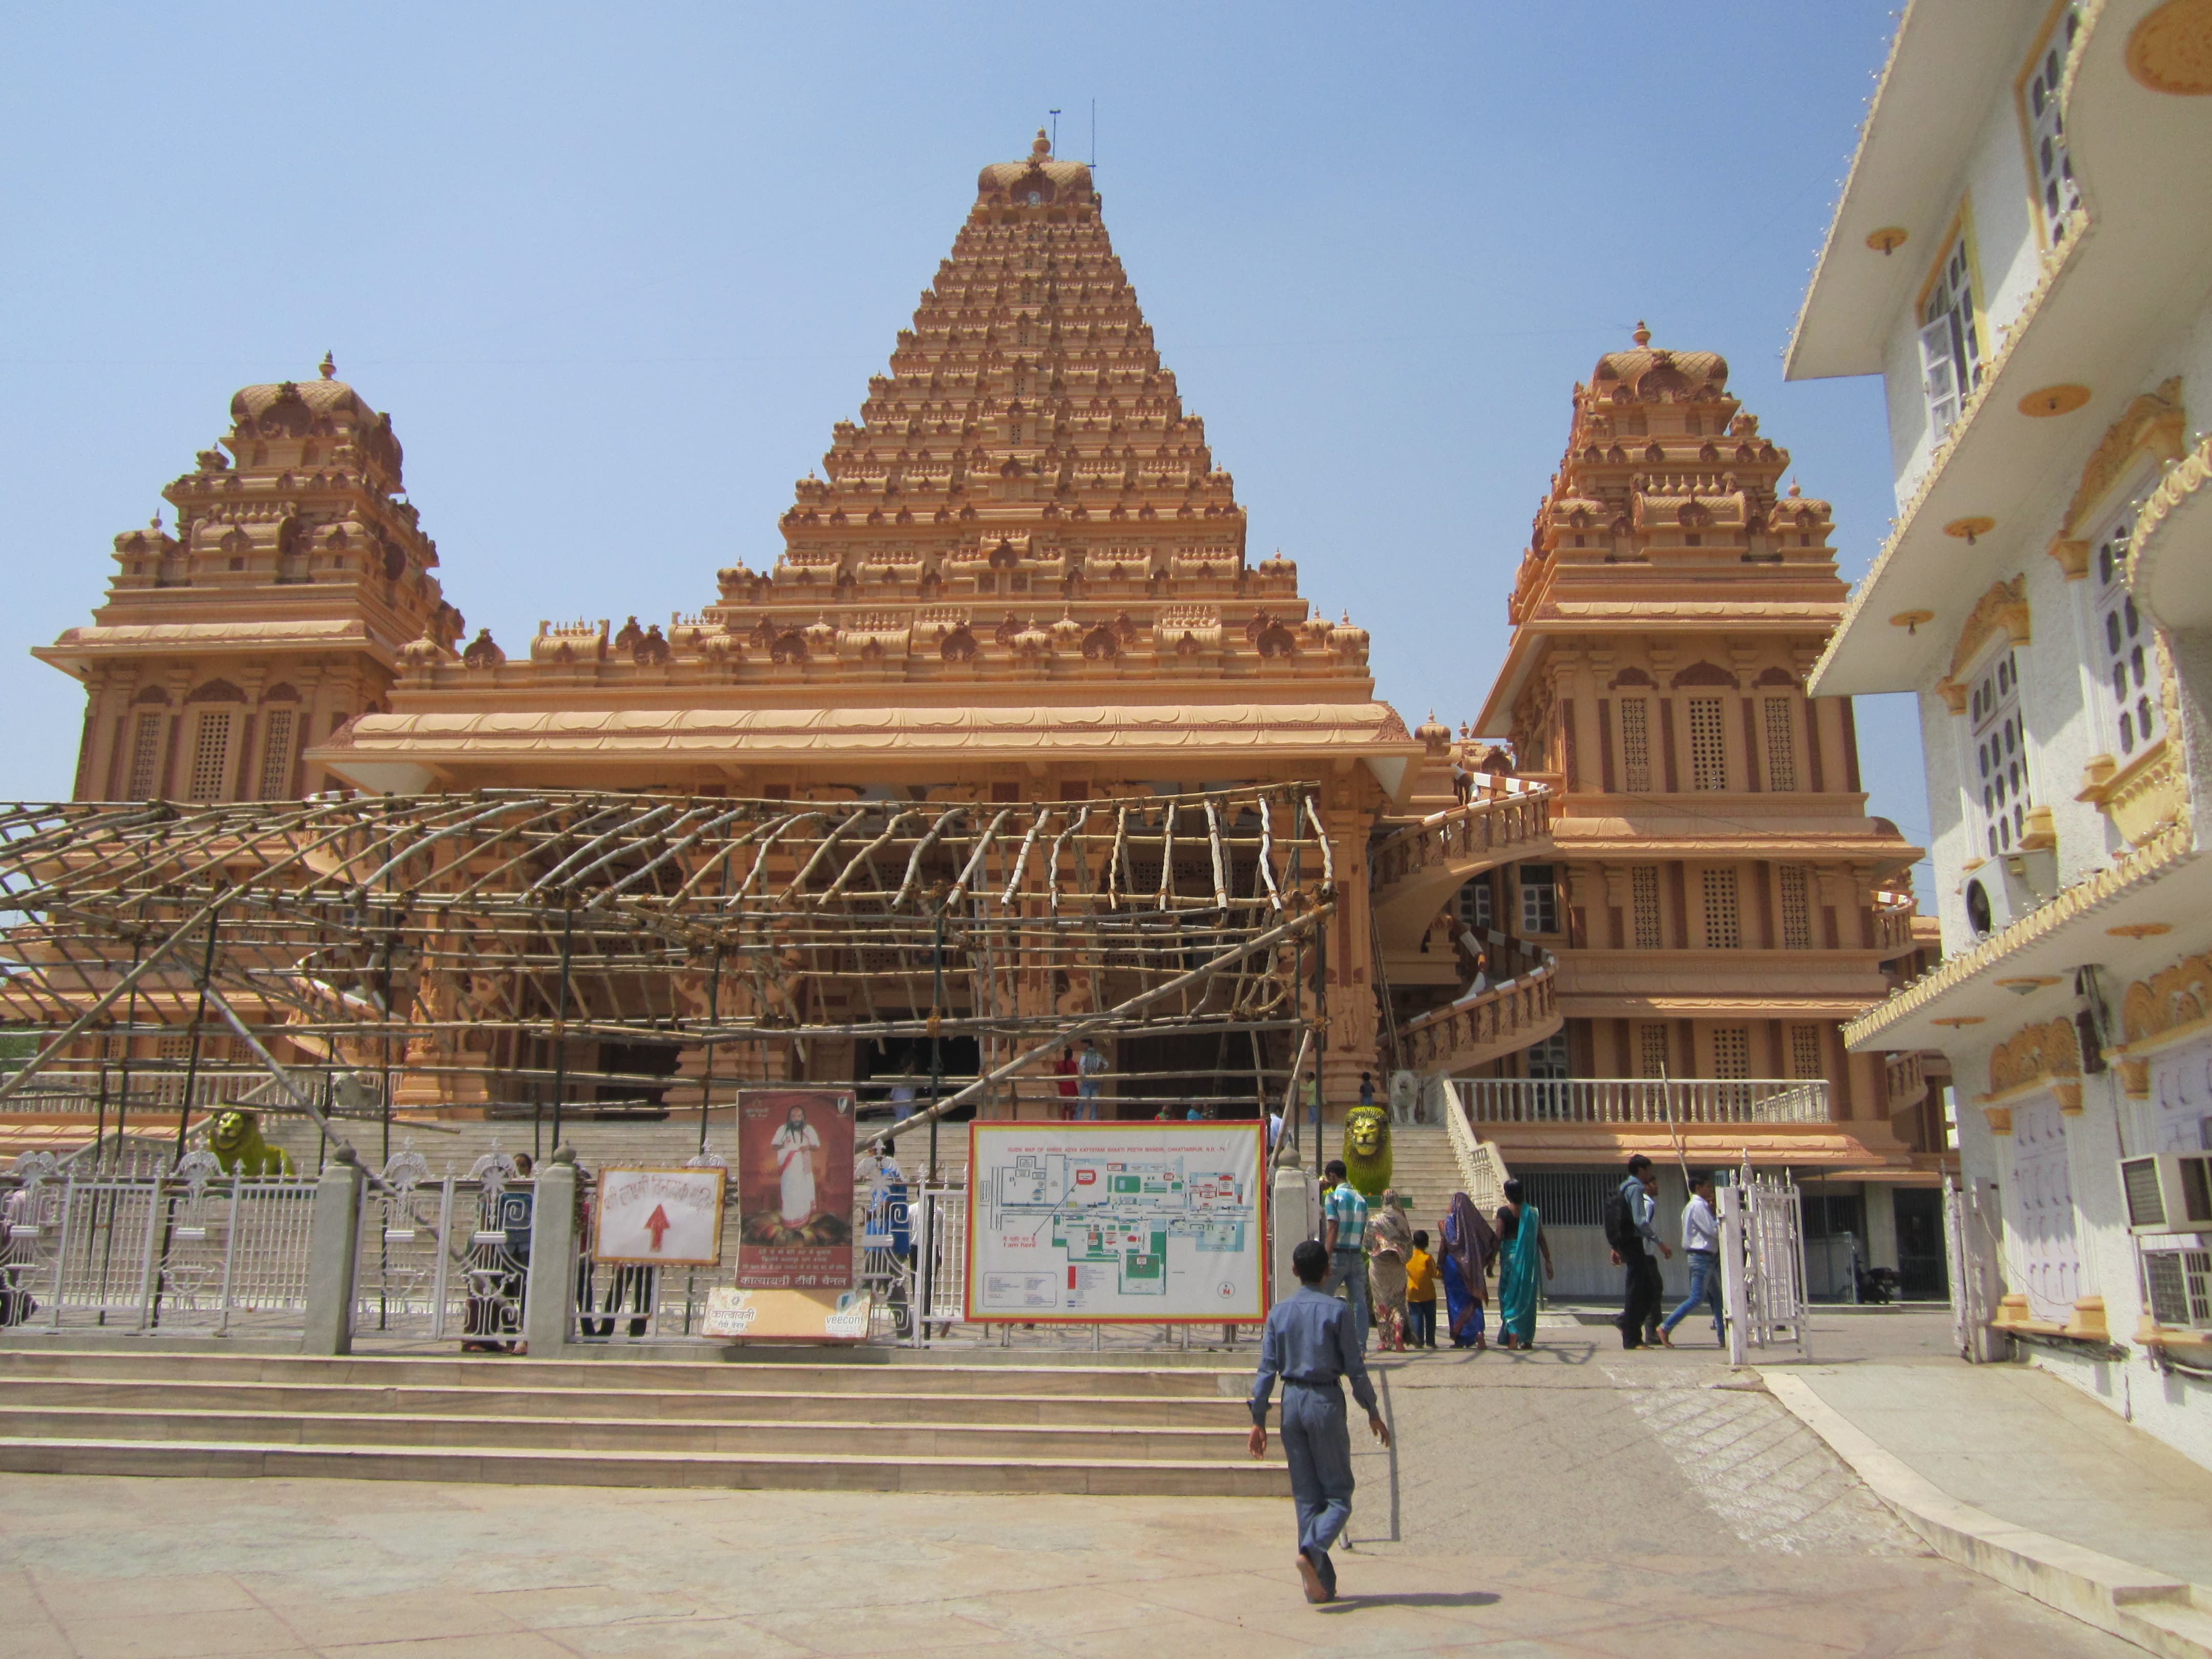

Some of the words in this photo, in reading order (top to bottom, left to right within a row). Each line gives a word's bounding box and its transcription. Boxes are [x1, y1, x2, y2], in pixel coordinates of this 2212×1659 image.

[740, 1275, 790, 1286] कात्यायनी
[795, 1275, 816, 1286] टीवी
[821, 1275, 846, 1286] चैनल
[711, 1308, 754, 1320] कात्यायनी
[826, 1316, 860, 1324] veecon
